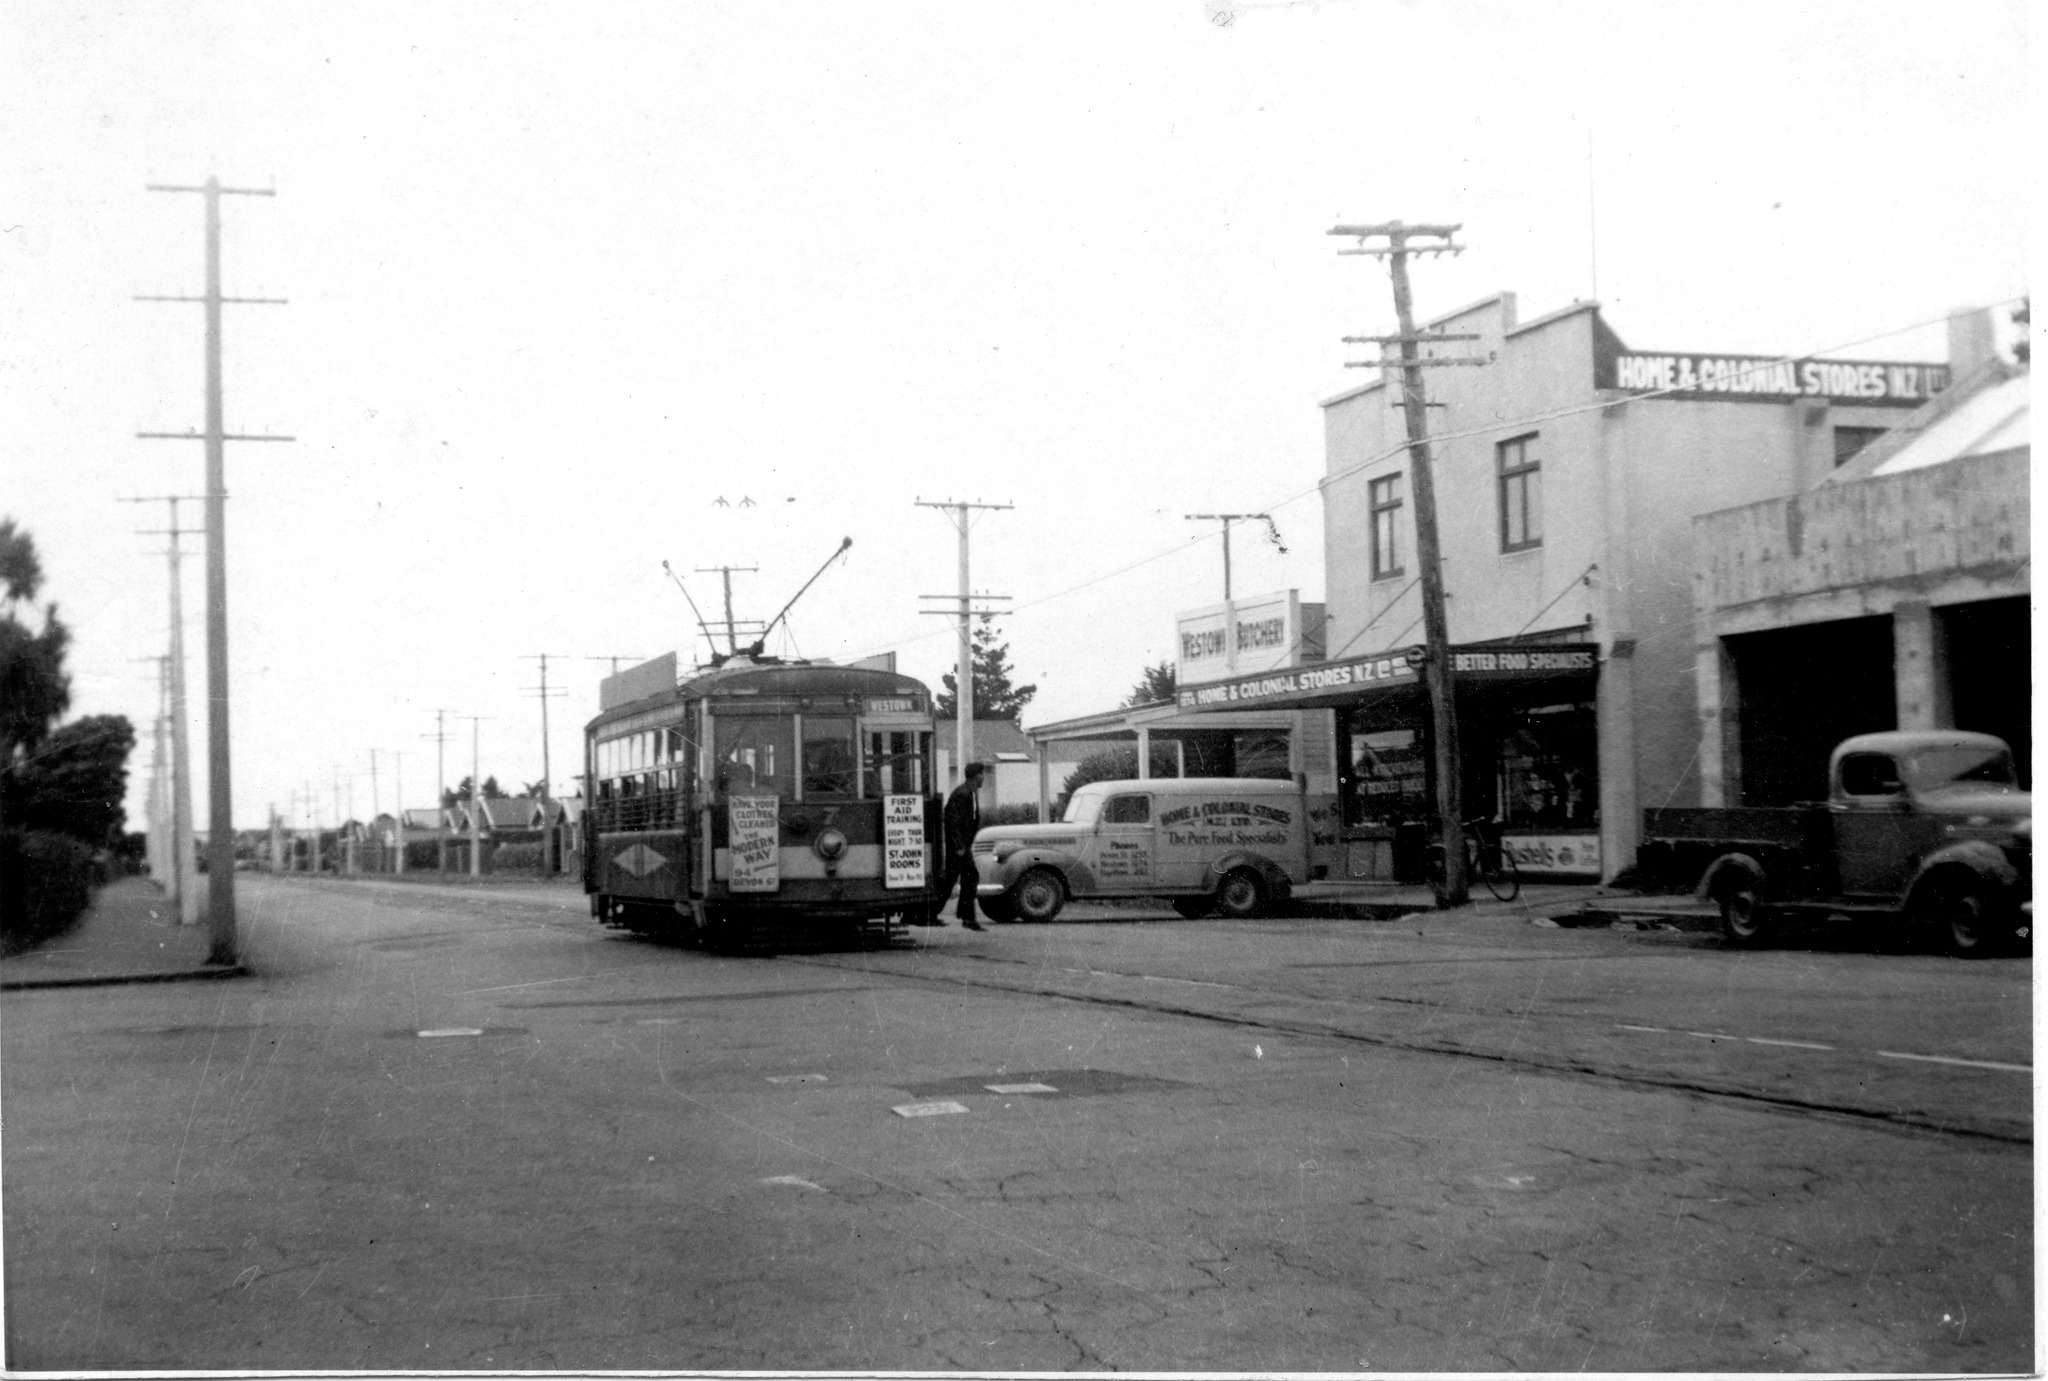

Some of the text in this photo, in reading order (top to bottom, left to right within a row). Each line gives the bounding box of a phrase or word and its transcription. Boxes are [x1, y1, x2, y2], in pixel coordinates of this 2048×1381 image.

[1617, 356, 1676, 389] HOME
[1678, 357, 1697, 390] &
[1698, 359, 1802, 395] COLONIAL
[1802, 362, 1887, 398] STORES
[1182, 617, 1285, 661] WESTOWN BUTCHERY
[1455, 653, 1497, 671] BETTER
[1499, 653, 1528, 670] FOOD
[1529, 652, 1594, 670] SPECIALISTS
[1197, 686, 1228, 705] HOME
[1229, 685, 1239, 701] &
[1240, 675, 1298, 699] COLONIAL
[1299, 666, 1352, 690] STORES
[891, 797, 916, 806] FIRST
[736, 810, 775, 819] CLOTHES
[894, 806, 912, 814] AID
[1160, 805, 1191, 826] HOME
[1201, 801, 1251, 816] COLONIAL
[823, 806, 840, 825] 7
[886, 814, 922, 824] TRAINING
[738, 819, 776, 829] CLEANED
[744, 831, 759, 840] THE
[887, 829, 904, 837] EVERY
[1187, 831, 1209, 845] Pure
[1210, 831, 1233, 844] Food
[731, 835, 775, 855] MODERN
[888, 837, 905, 846] NIGHT
[744, 848, 771, 864] WAY
[899, 849, 922, 858] JOHN
[889, 859, 921, 869] ROOMS
[734, 868, 751, 877] 94
[733, 878, 764, 886] DEVON
